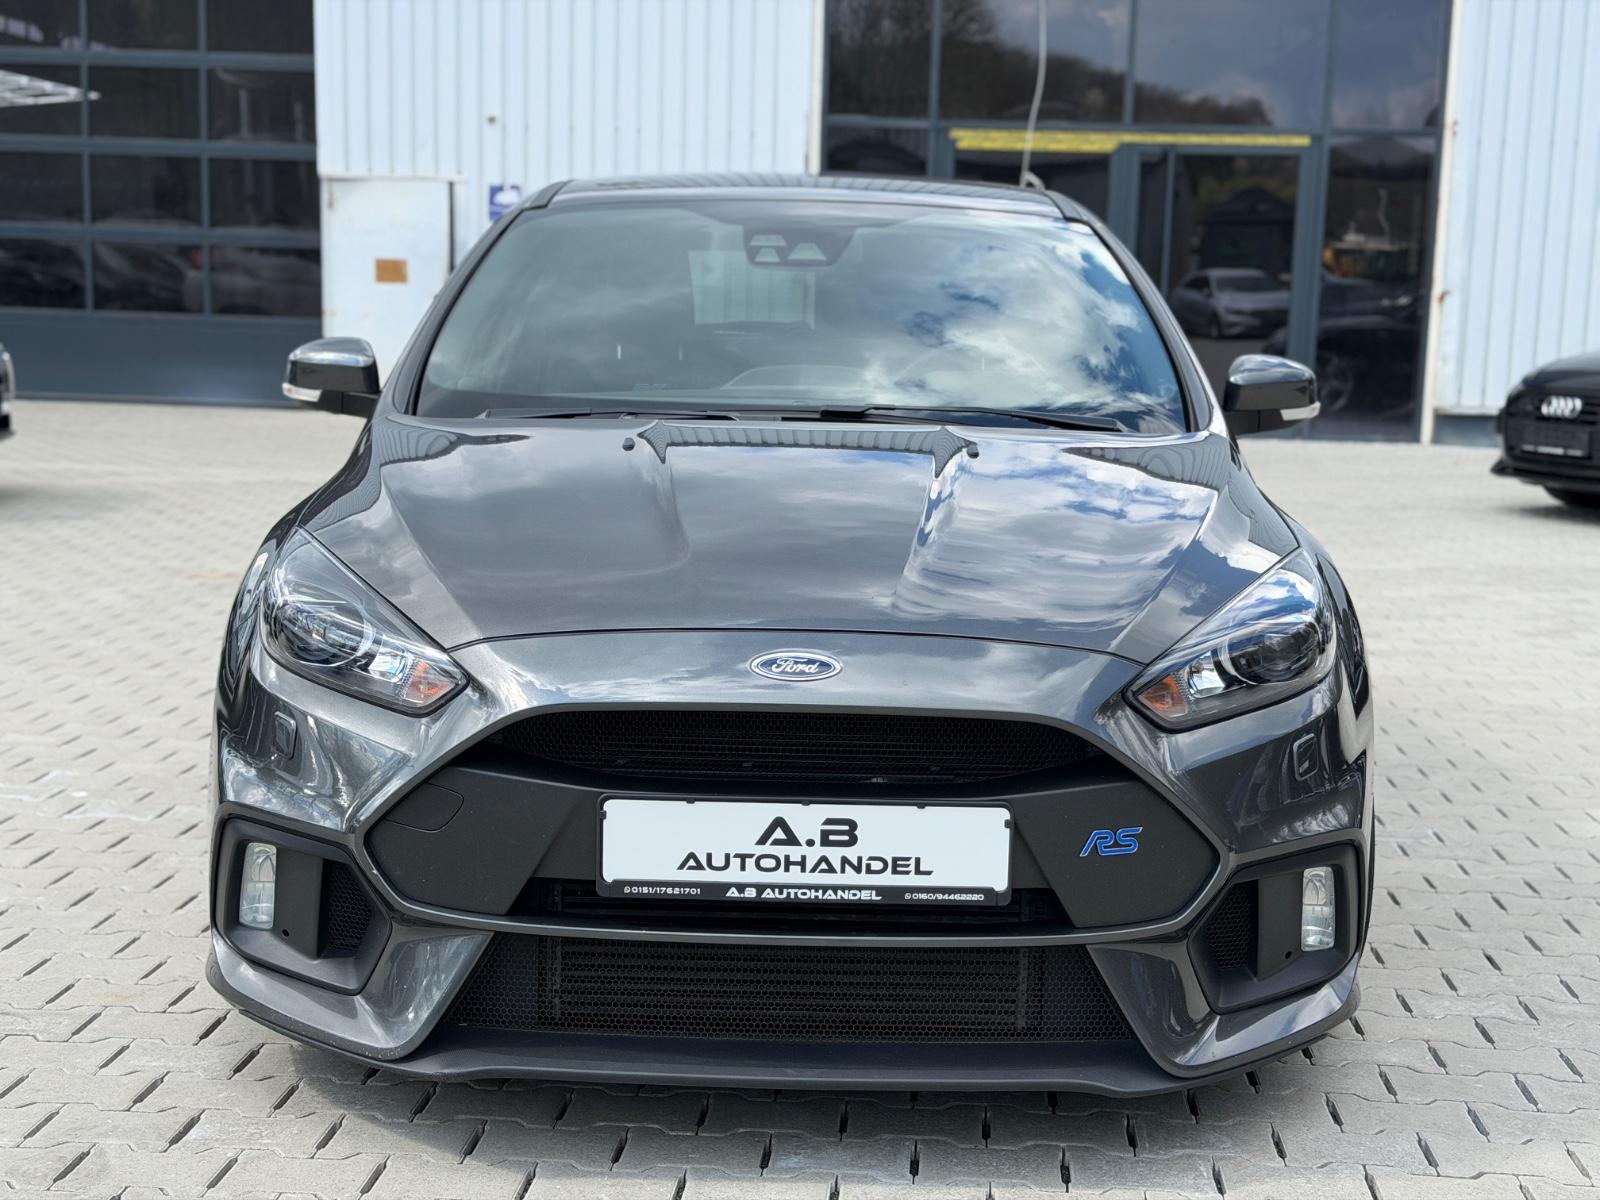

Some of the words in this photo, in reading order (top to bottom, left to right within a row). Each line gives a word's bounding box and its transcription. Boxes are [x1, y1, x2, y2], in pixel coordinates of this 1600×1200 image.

[772, 658, 819, 673] Ford
[755, 816, 858, 848] A.B
[1080, 827, 1143, 857] RS
[676, 851, 934, 876] AUTOHANDEL
[632, 886, 700, 895] 0151/17621701
[726, 887, 756, 898] A.B
[761, 888, 882, 900] AUTOHANDEL
[912, 892, 984, 900] 0160/94462220
